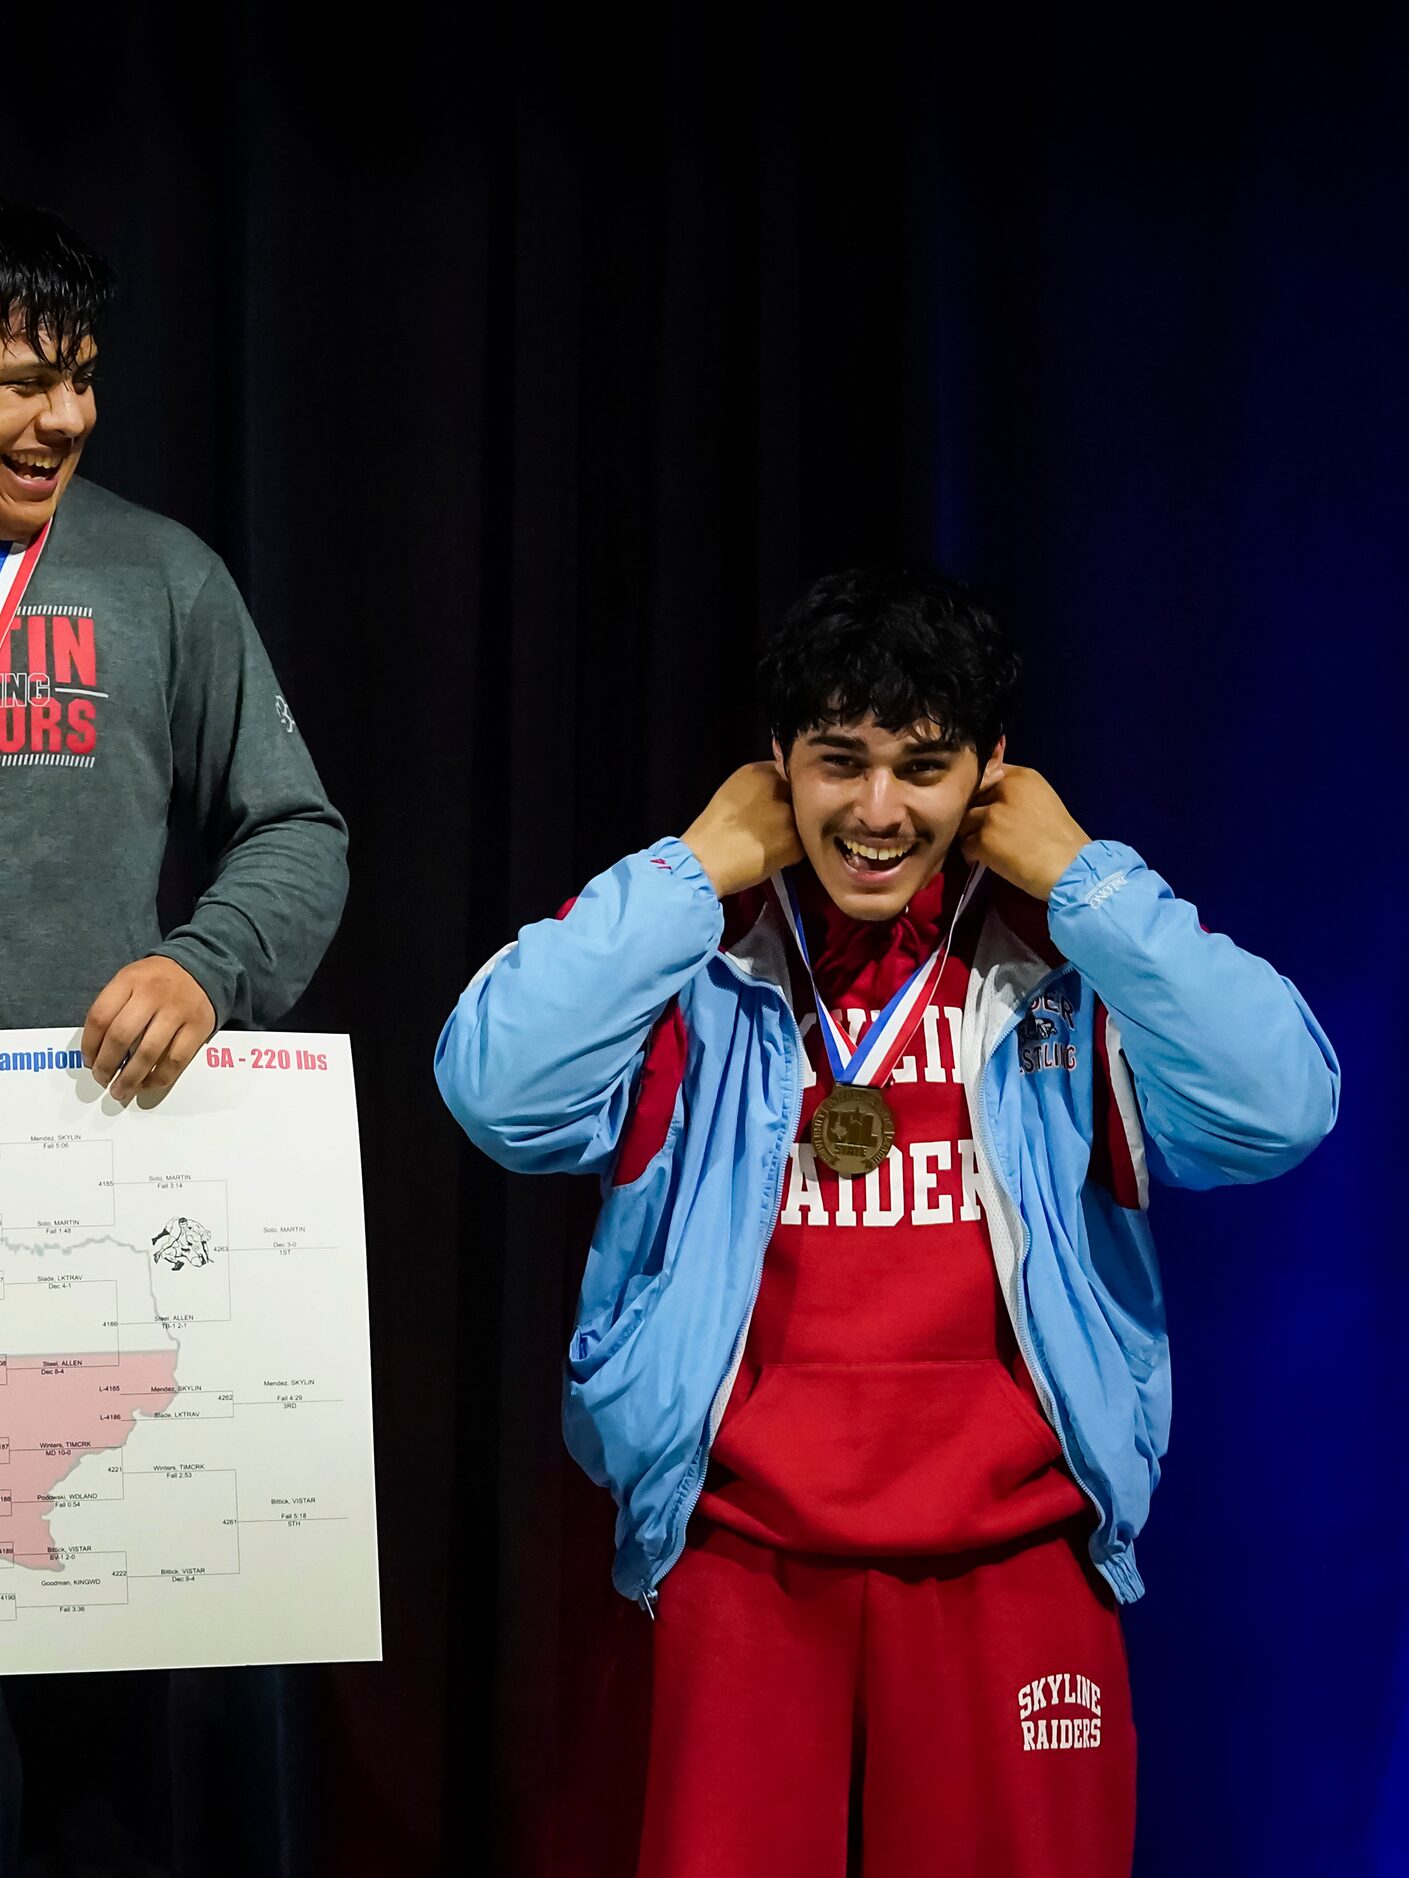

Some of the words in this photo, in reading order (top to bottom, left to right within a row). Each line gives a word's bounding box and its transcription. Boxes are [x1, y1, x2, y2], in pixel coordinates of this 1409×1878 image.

[206, 1047, 234, 1068] 6A
[251, 1048, 290, 1069] 220
[296, 1050, 328, 1070] lbs
[1018, 1673, 1101, 1720] SKYLINE
[1021, 1719, 1101, 1751] RAIDERS
